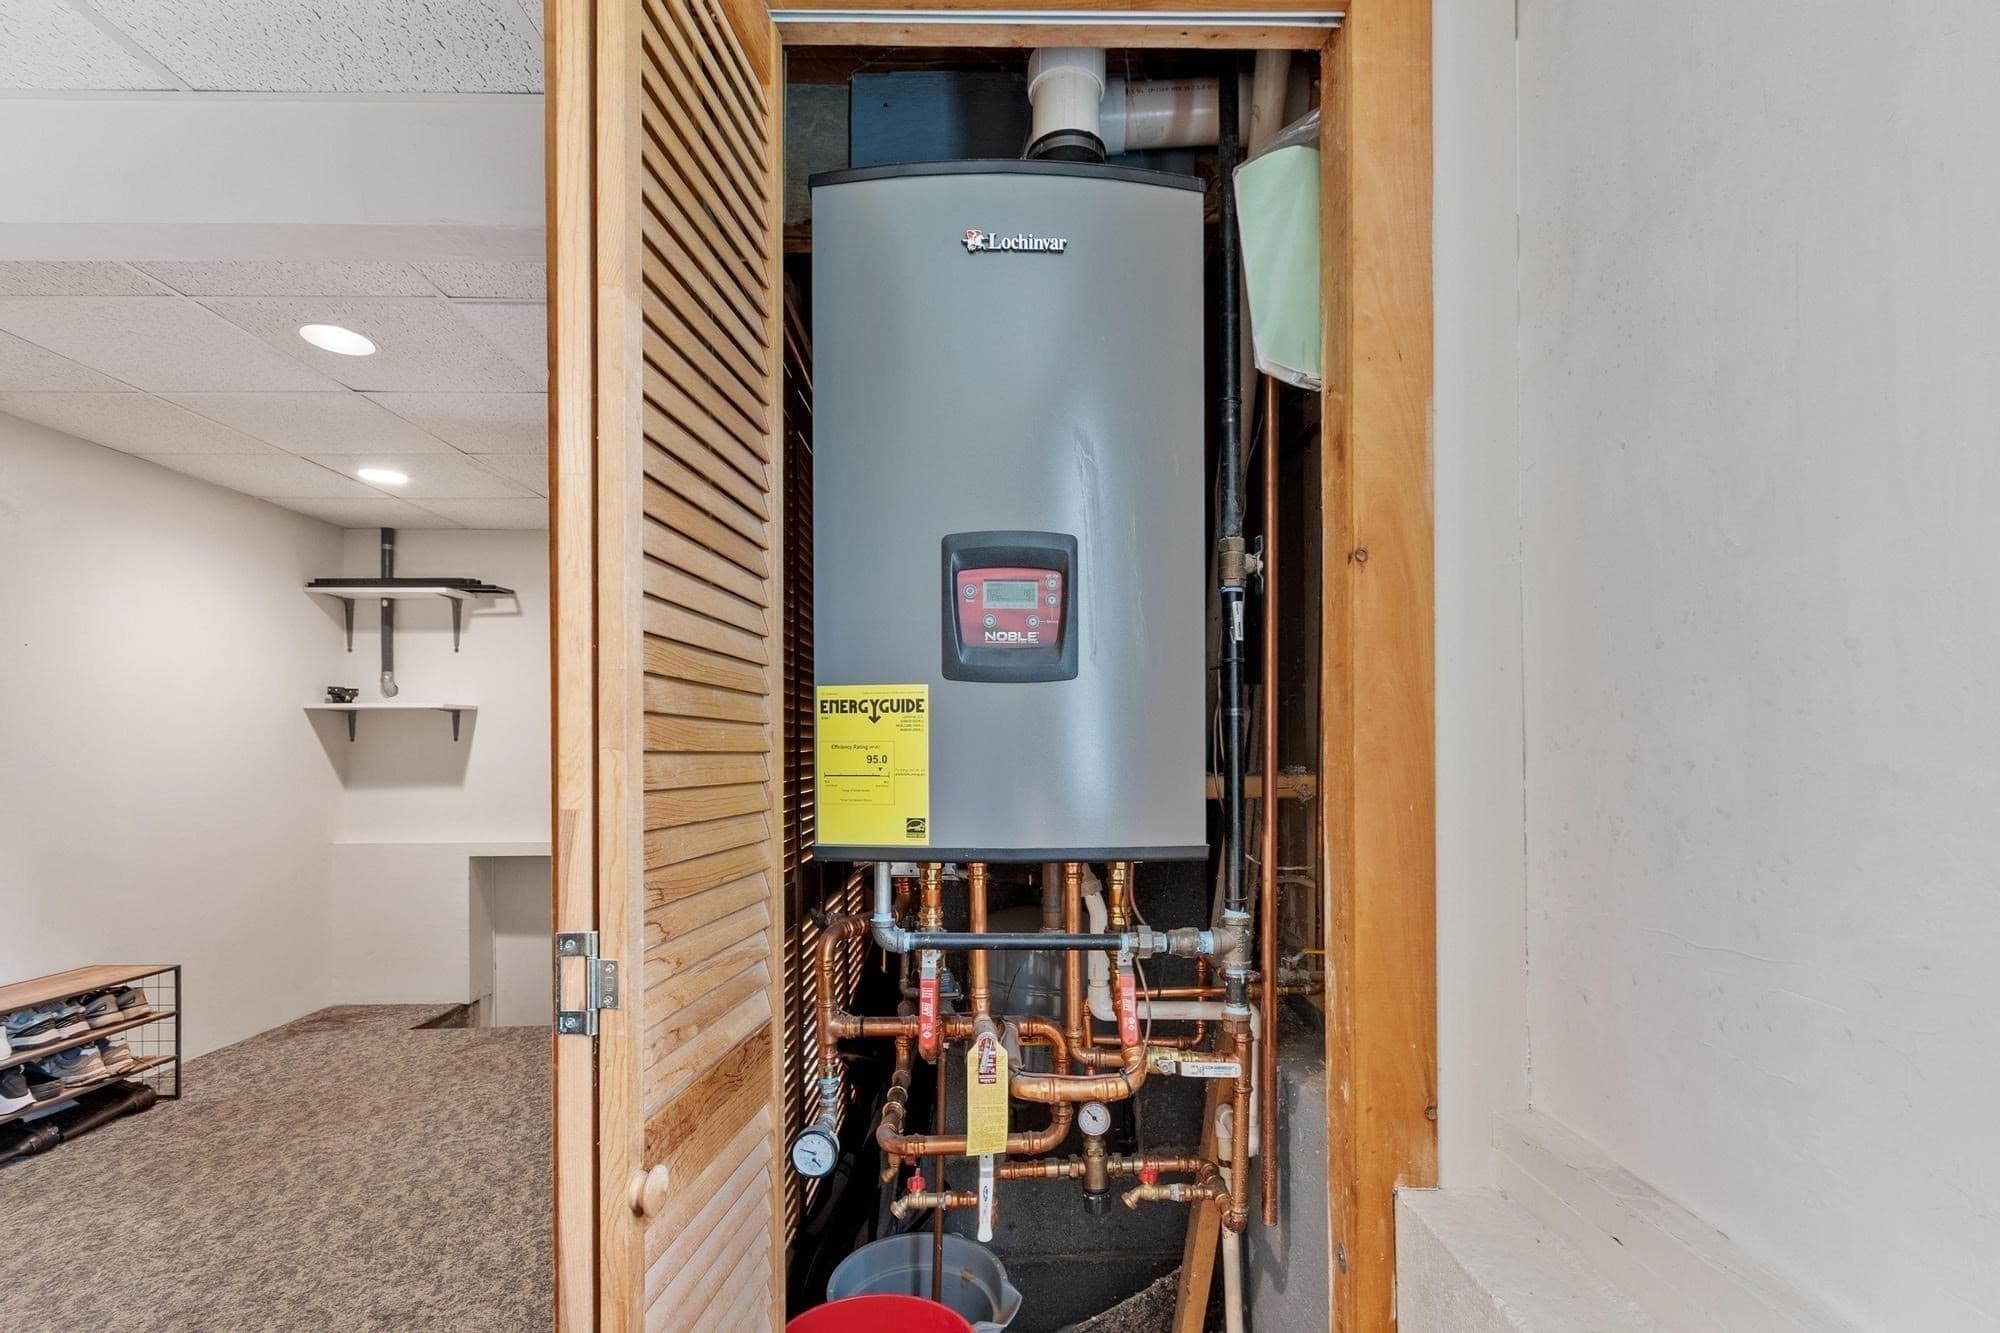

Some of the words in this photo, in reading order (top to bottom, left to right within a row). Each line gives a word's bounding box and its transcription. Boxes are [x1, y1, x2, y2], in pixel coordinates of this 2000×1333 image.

[988, 232, 1068, 251] Lochinvar
[984, 631, 1038, 642] NOBLE
[820, 698, 925, 717] ENERGYGUIDE
[831, 743, 853, 751] Efficiency
[853, 743, 869, 751] Rating
[866, 754, 888, 765] 95.0
